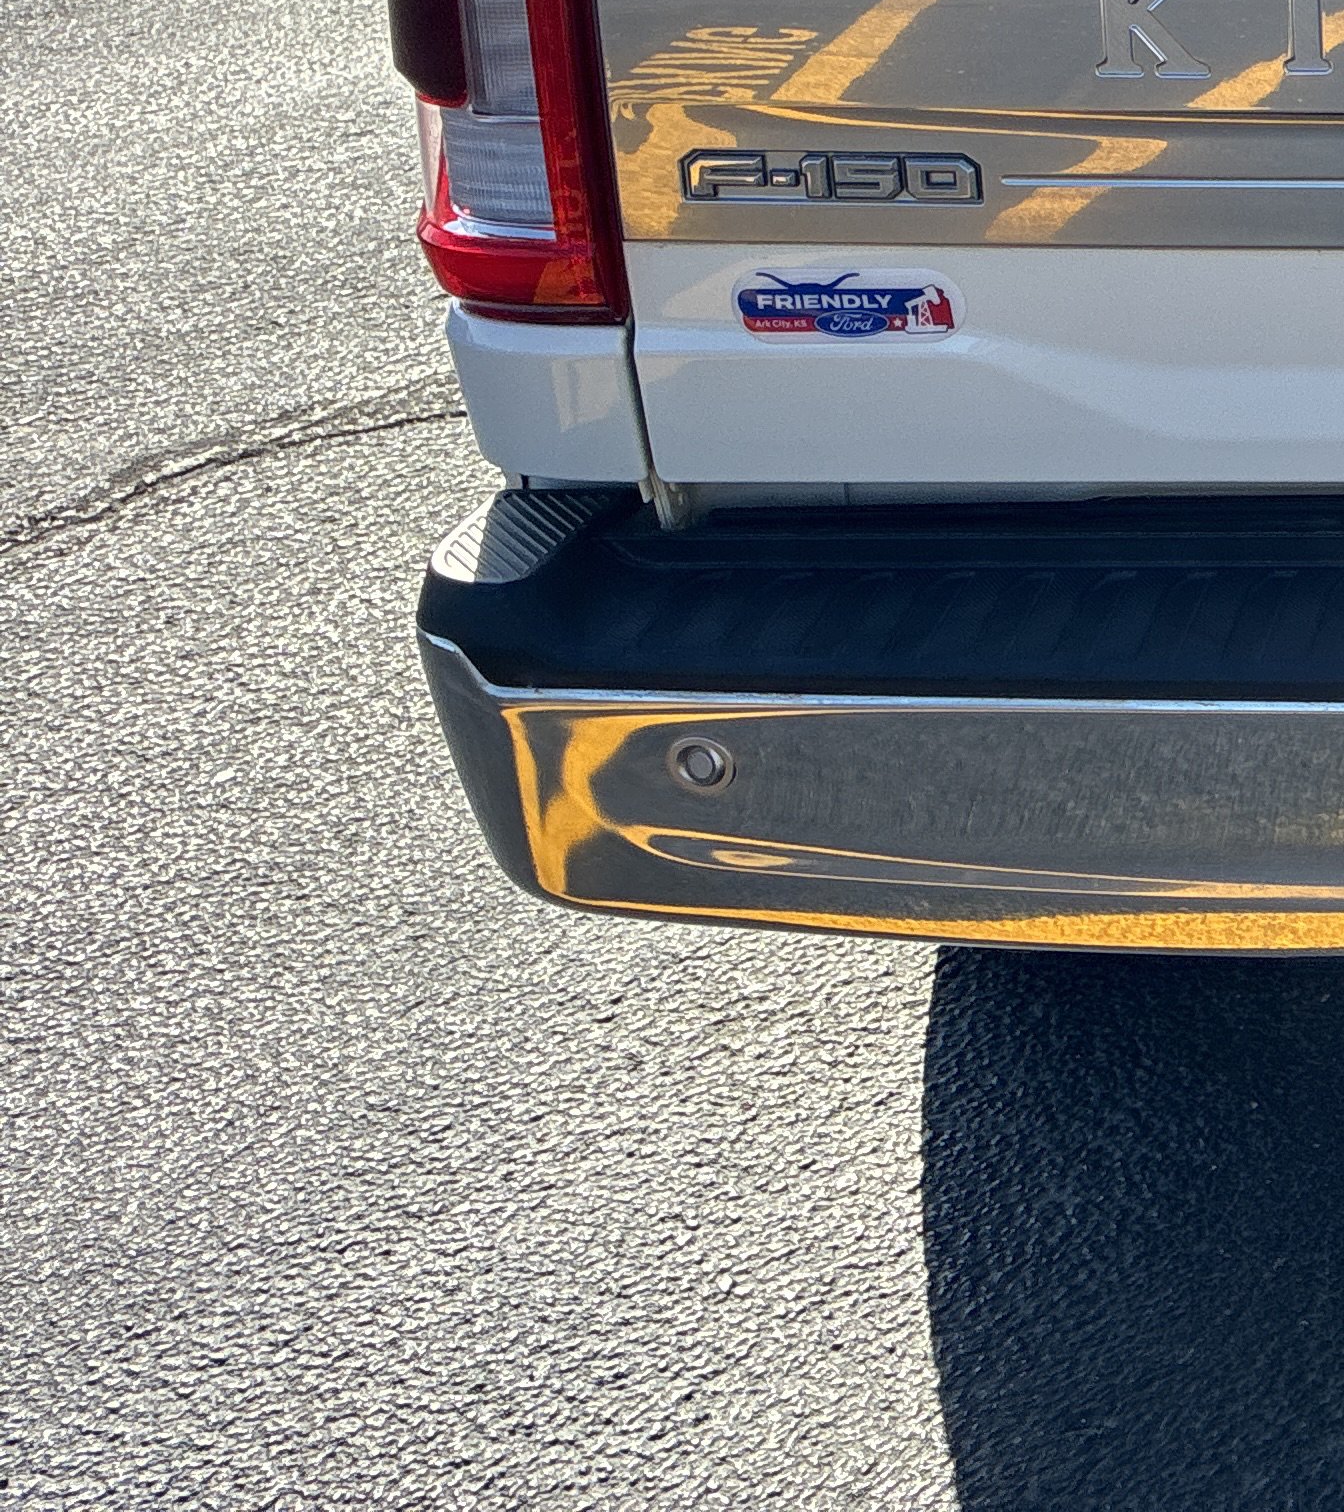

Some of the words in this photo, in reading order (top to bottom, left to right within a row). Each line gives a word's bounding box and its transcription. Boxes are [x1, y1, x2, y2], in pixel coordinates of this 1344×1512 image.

[678, 148, 985, 204] F-150
[756, 293, 893, 310] FRIENDLY
[754, 318, 771, 329] Ark
[793, 319, 808, 329] KS
[828, 312, 875, 332] Ford
